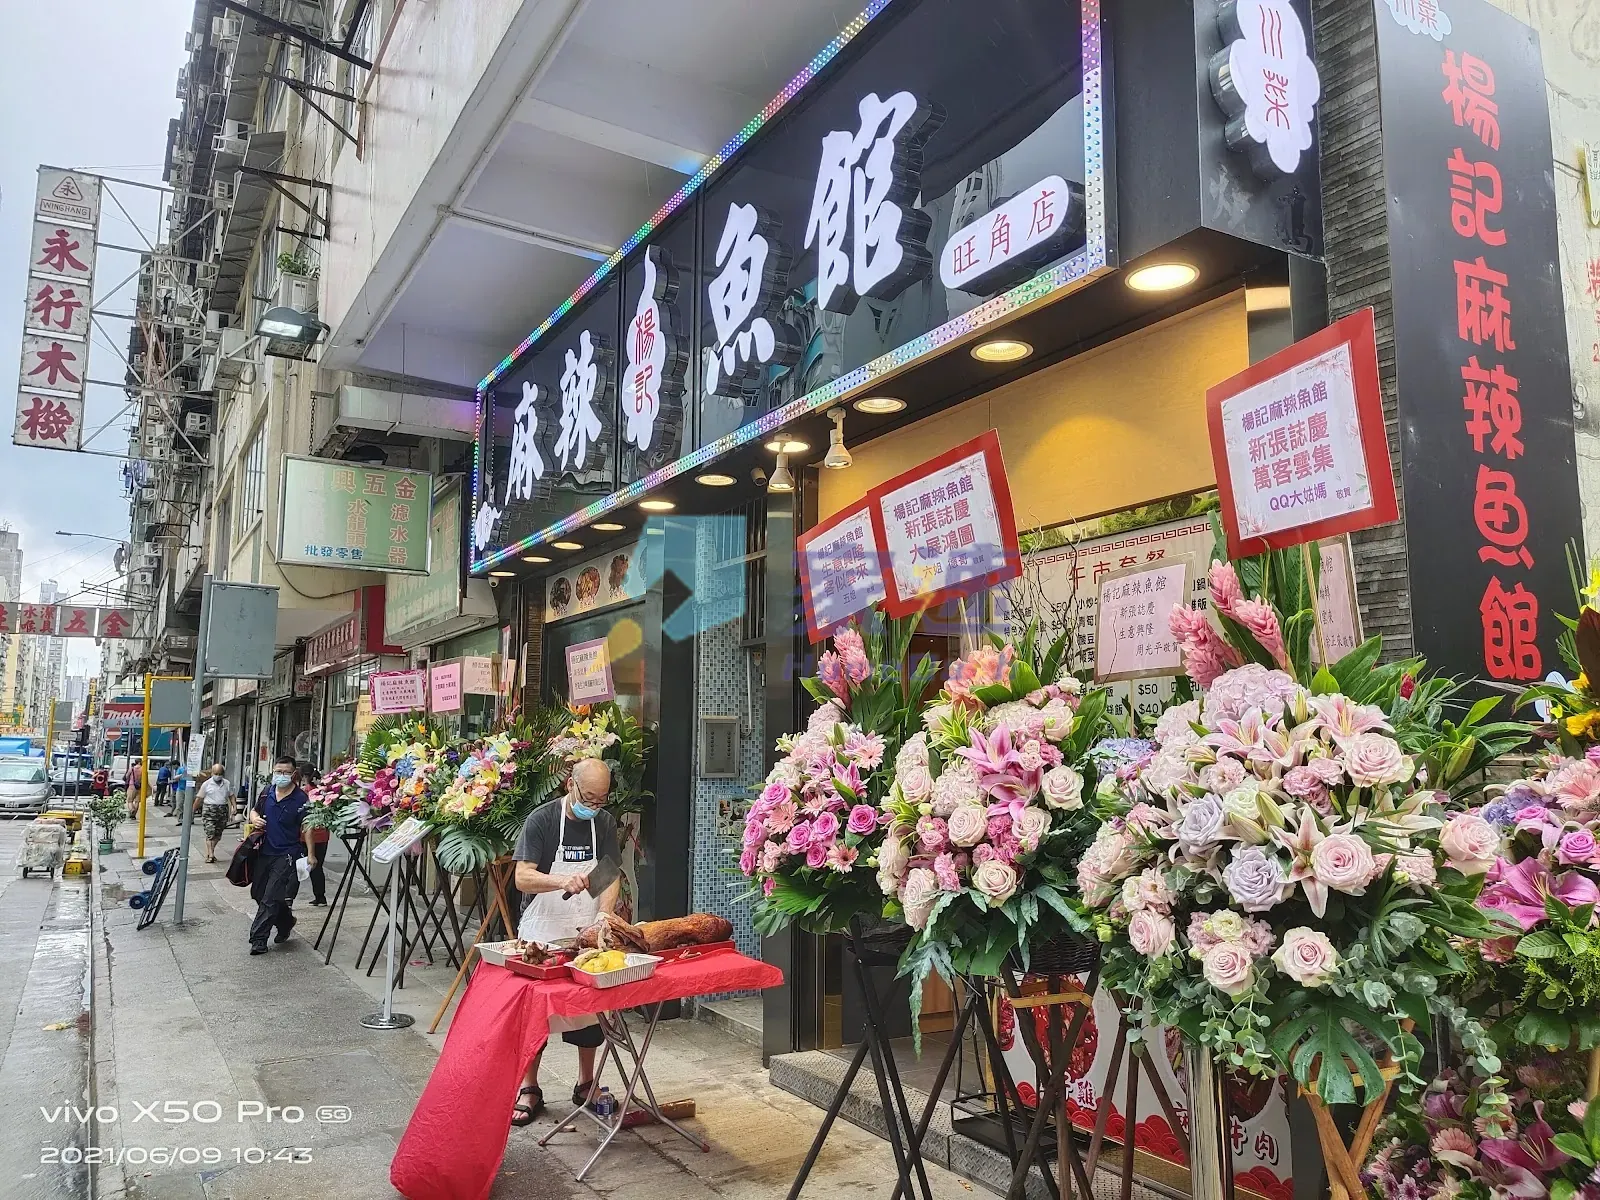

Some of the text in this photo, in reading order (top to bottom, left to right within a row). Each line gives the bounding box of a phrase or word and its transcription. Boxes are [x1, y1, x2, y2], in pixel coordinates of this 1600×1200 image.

[60, 181, 77, 197] 永
[953, 189, 1057, 277] 旺角店
[20, 229, 89, 444] 永行木機
[1441, 47, 1542, 681] 楊記麻辣魚館
[1241, 380, 1329, 433] 楊記麻辣魚館
[1247, 411, 1330, 464] 新張誌慶
[1251, 443, 1335, 493] 萬客雲集
[893, 474, 974, 521] 楊記麻辣魚館
[1269, 481, 1328, 512] QQ大姑媽
[904, 498, 971, 540] 新張誌慶
[304, 545, 364, 560] 批發零售
[822, 543, 866, 580] 生意興隆
[909, 523, 976, 564] 大展鴻圖
[1102, 575, 1168, 604] 楊記麻辣魚館
[1118, 622, 1155, 641] 生意興隆
[1138, 684, 1158, 695] $50
[1138, 703, 1159, 715] $40
